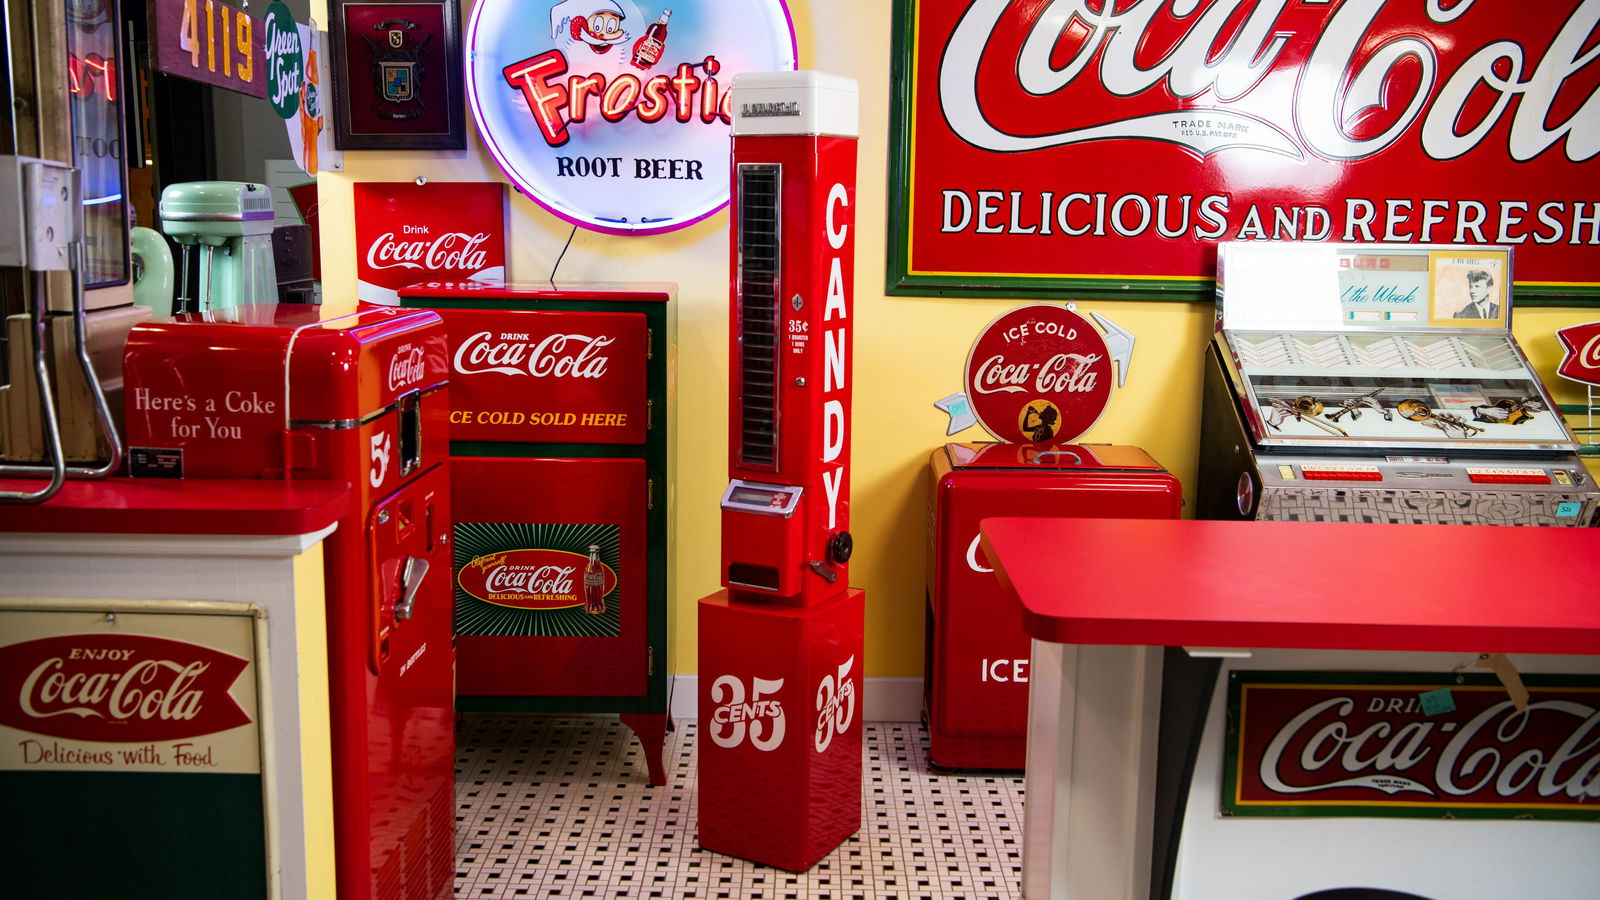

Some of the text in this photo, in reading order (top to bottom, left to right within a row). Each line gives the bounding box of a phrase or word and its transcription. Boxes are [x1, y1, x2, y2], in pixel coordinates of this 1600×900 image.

[180, 0, 254, 82] 4119
[264, 12, 300, 81] Green
[272, 56, 300, 108] Spot
[939, 0, 1600, 166] CocaCol
[1172, 120, 1249, 133] TRADE MARK
[556, 156, 704, 181] ROOT BEER
[403, 224, 429, 234] Drink
[939, 189, 1600, 245] DELICIOUS AND REFRESH
[367, 232, 491, 270] Coca-Cola
[1349, 285, 1369, 302] the
[1371, 285, 1420, 303] Week
[500, 332, 530, 341] DRINK
[789, 320, 808, 332] 35¢
[1003, 321, 1077, 343] ICE COLD
[388, 345, 425, 392] Coca-Cola
[453, 331, 617, 379] Coca-Cola
[822, 183, 848, 528] CANDY
[973, 353, 1103, 394] Coca-Cola
[135, 388, 276, 414] Here's a Coke
[171, 417, 242, 440] for You
[449, 410, 628, 426] CE COLD SOLD HERE
[370, 430, 391, 488] 5¢
[485, 565, 577, 594] Coca-Cola
[68, 648, 135, 662] ENJOY
[981, 658, 1030, 682] ICE
[19, 656, 212, 721] Coca-Cola
[815, 653, 855, 754] 35
[817, 676, 853, 732] CENTS
[1367, 697, 1421, 713] DRI
[709, 674, 786, 752] 35
[713, 700, 782, 724] CENTS
[19, 739, 218, 767] Delicious with Food
[1260, 696, 1600, 798] Coca-Cola
